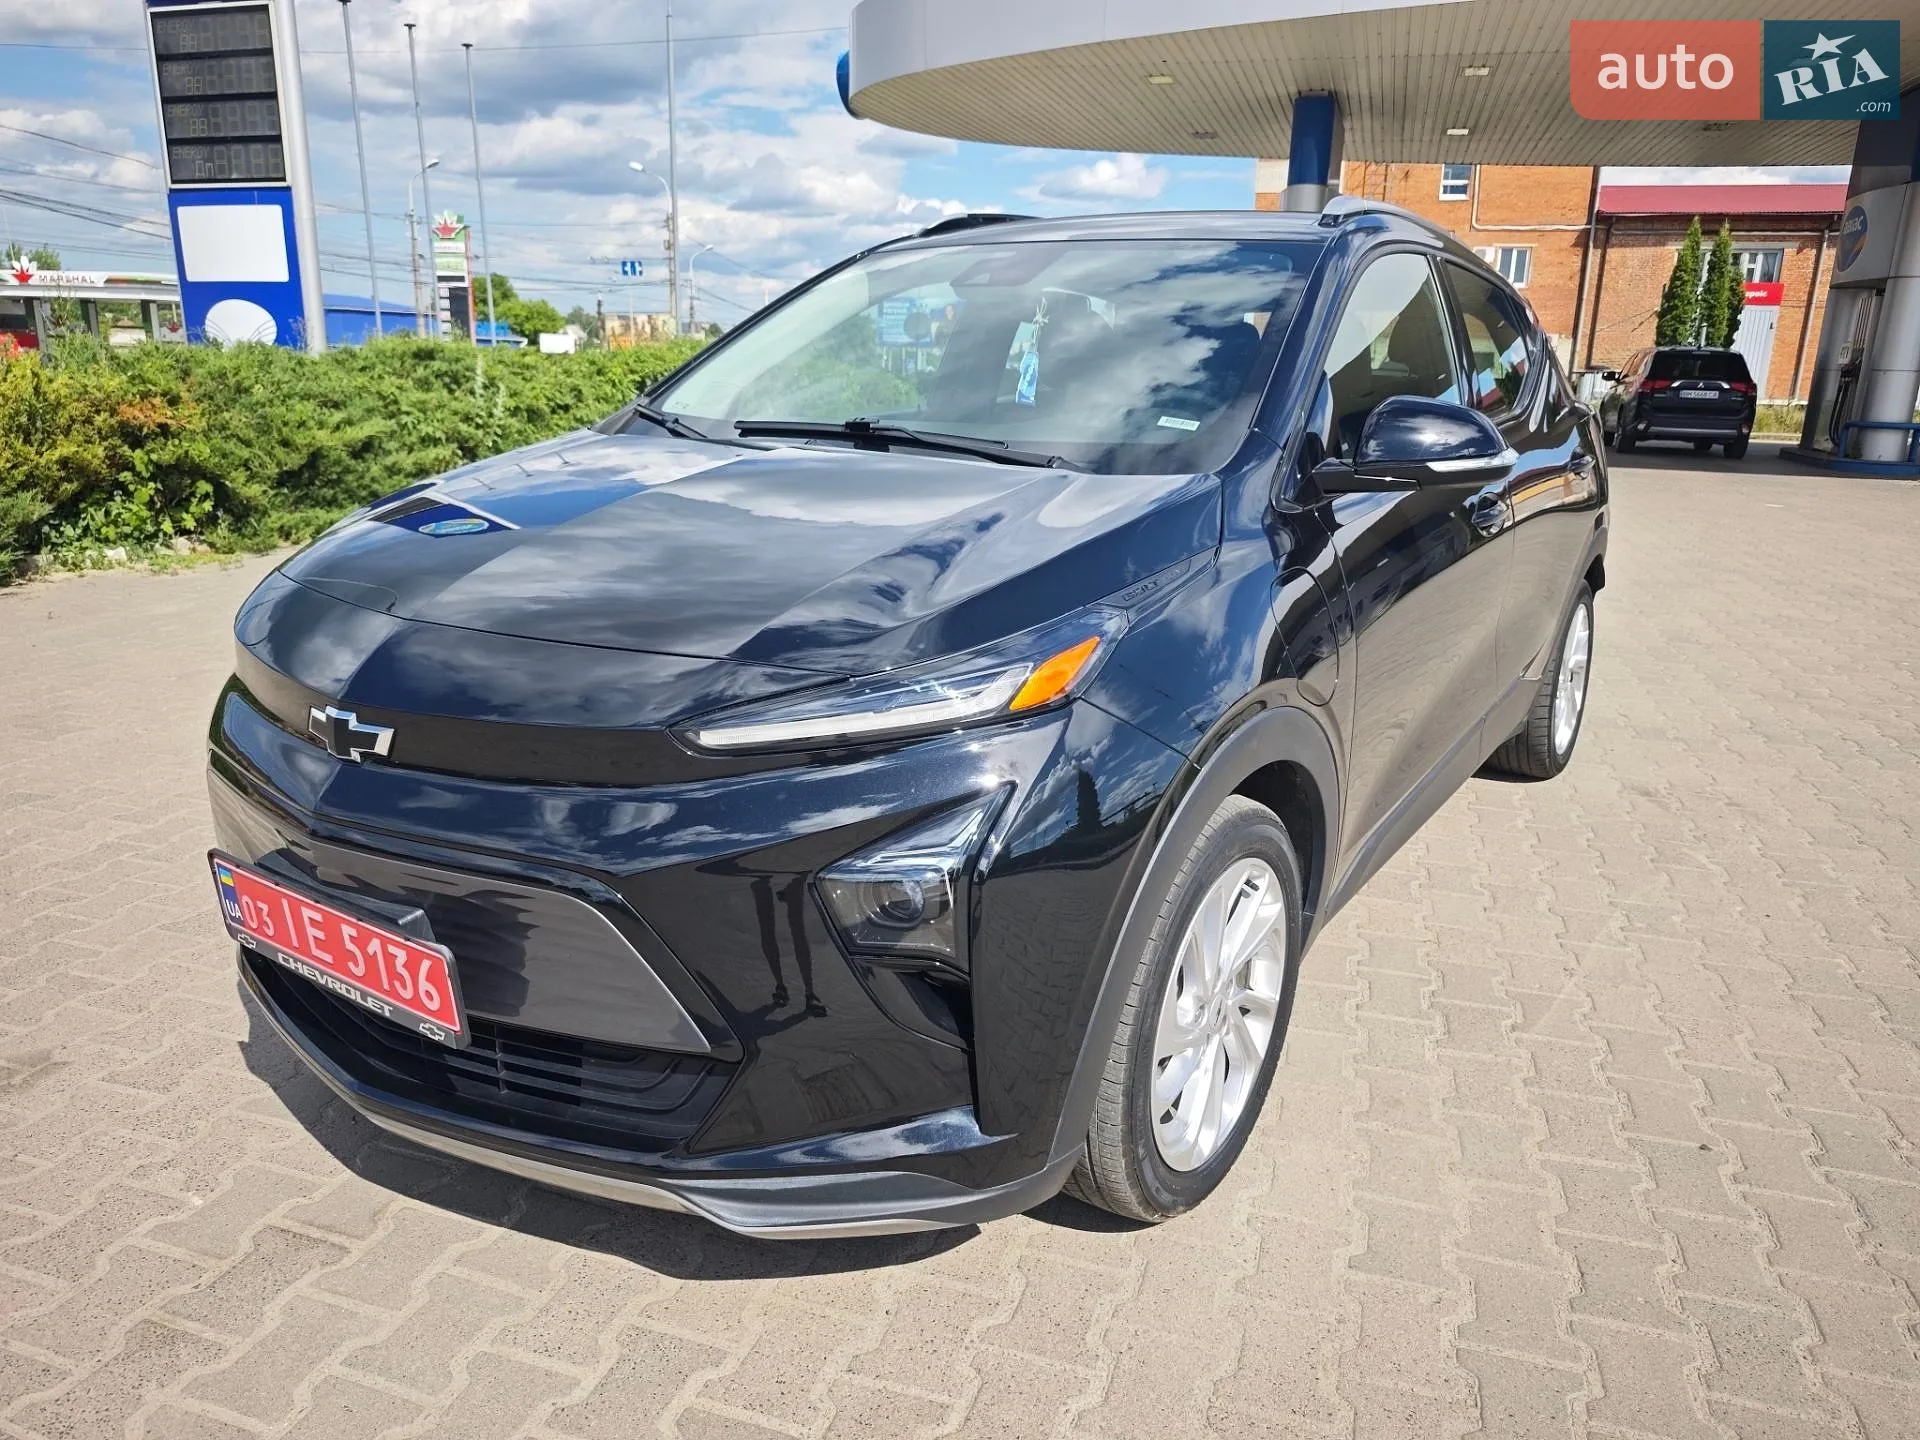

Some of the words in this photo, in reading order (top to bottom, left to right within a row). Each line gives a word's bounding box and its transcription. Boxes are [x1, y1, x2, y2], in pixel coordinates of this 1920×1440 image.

[39, 274, 95, 285] MARSHAL
[225, 899, 244, 921] UA
[241, 895, 275, 937] 03
[281, 898, 334, 965] IE
[340, 923, 441, 1012] 5136
[277, 952, 394, 1017] CHEVROLET
